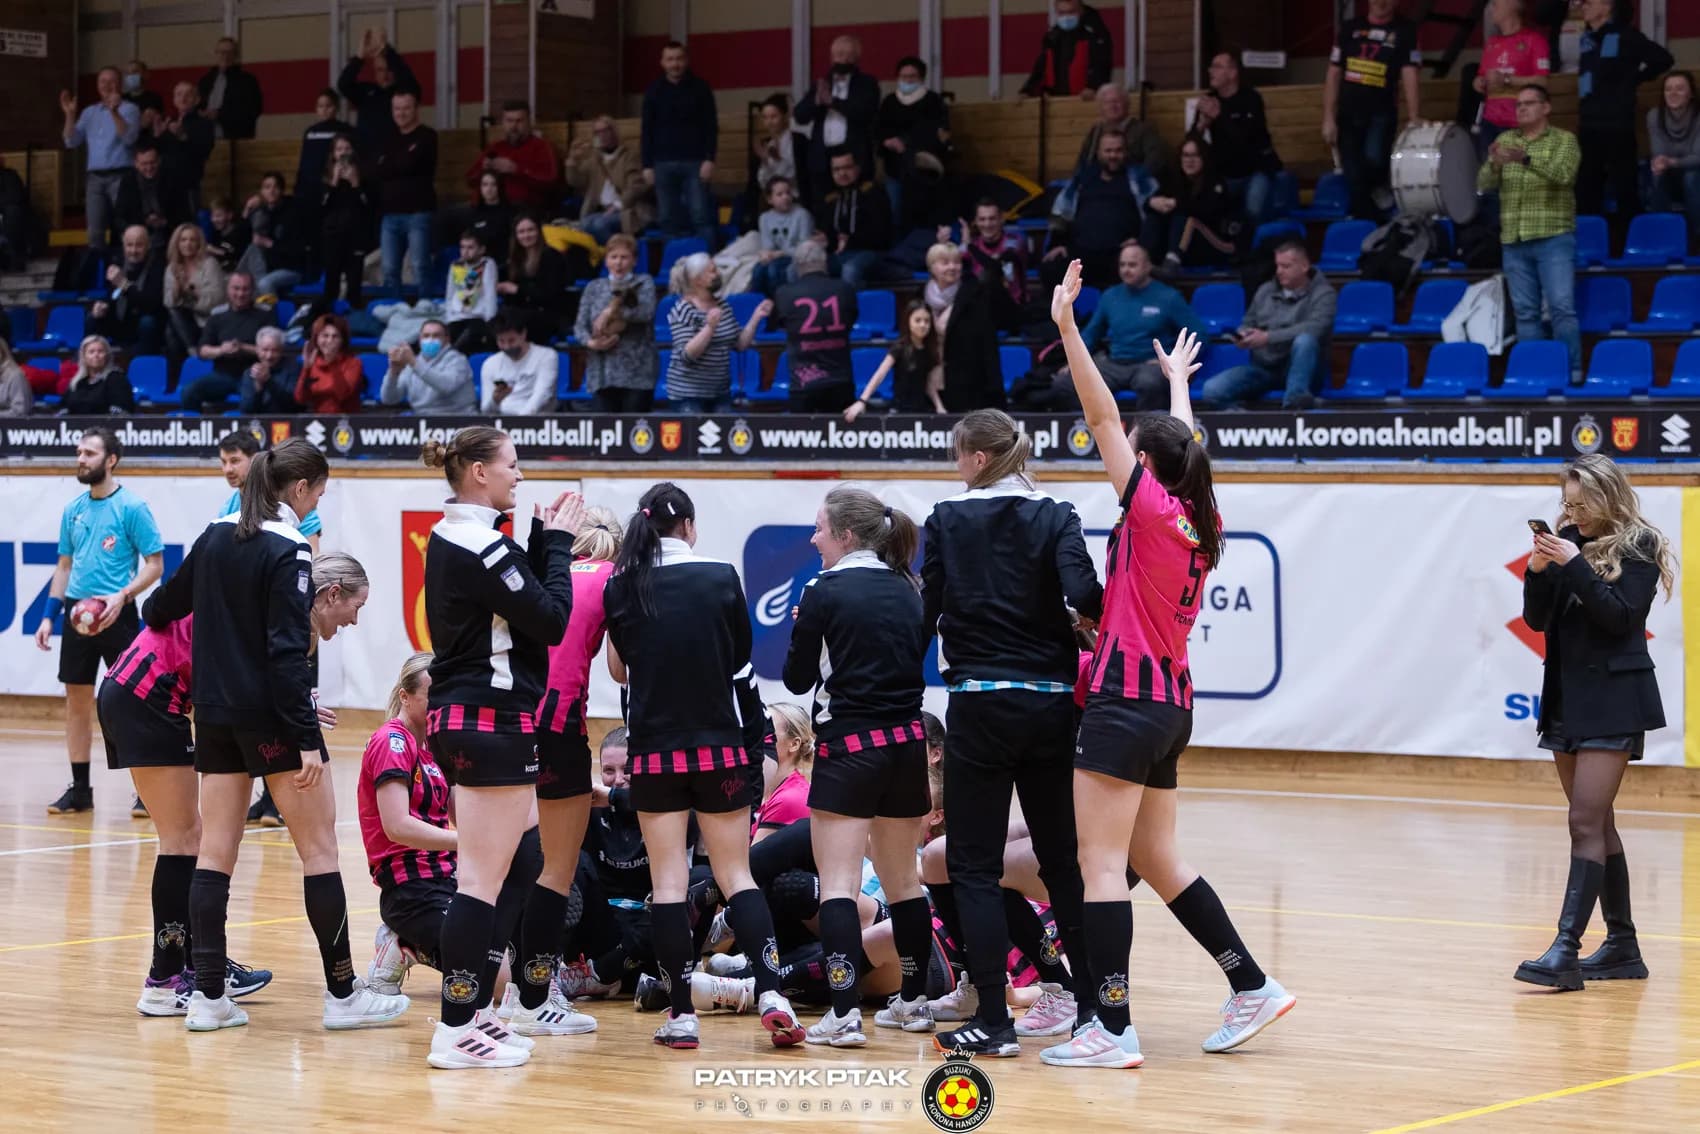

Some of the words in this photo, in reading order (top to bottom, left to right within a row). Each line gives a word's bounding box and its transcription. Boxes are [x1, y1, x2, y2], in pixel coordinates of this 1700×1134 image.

[794, 296, 846, 334] 21
[360, 419, 623, 454] www.korandball.pl
[760, 420, 1059, 454] www.koronahapl
[1217, 416, 1562, 455] www.koronahandball.pl
[1179, 547, 1212, 607] 5
